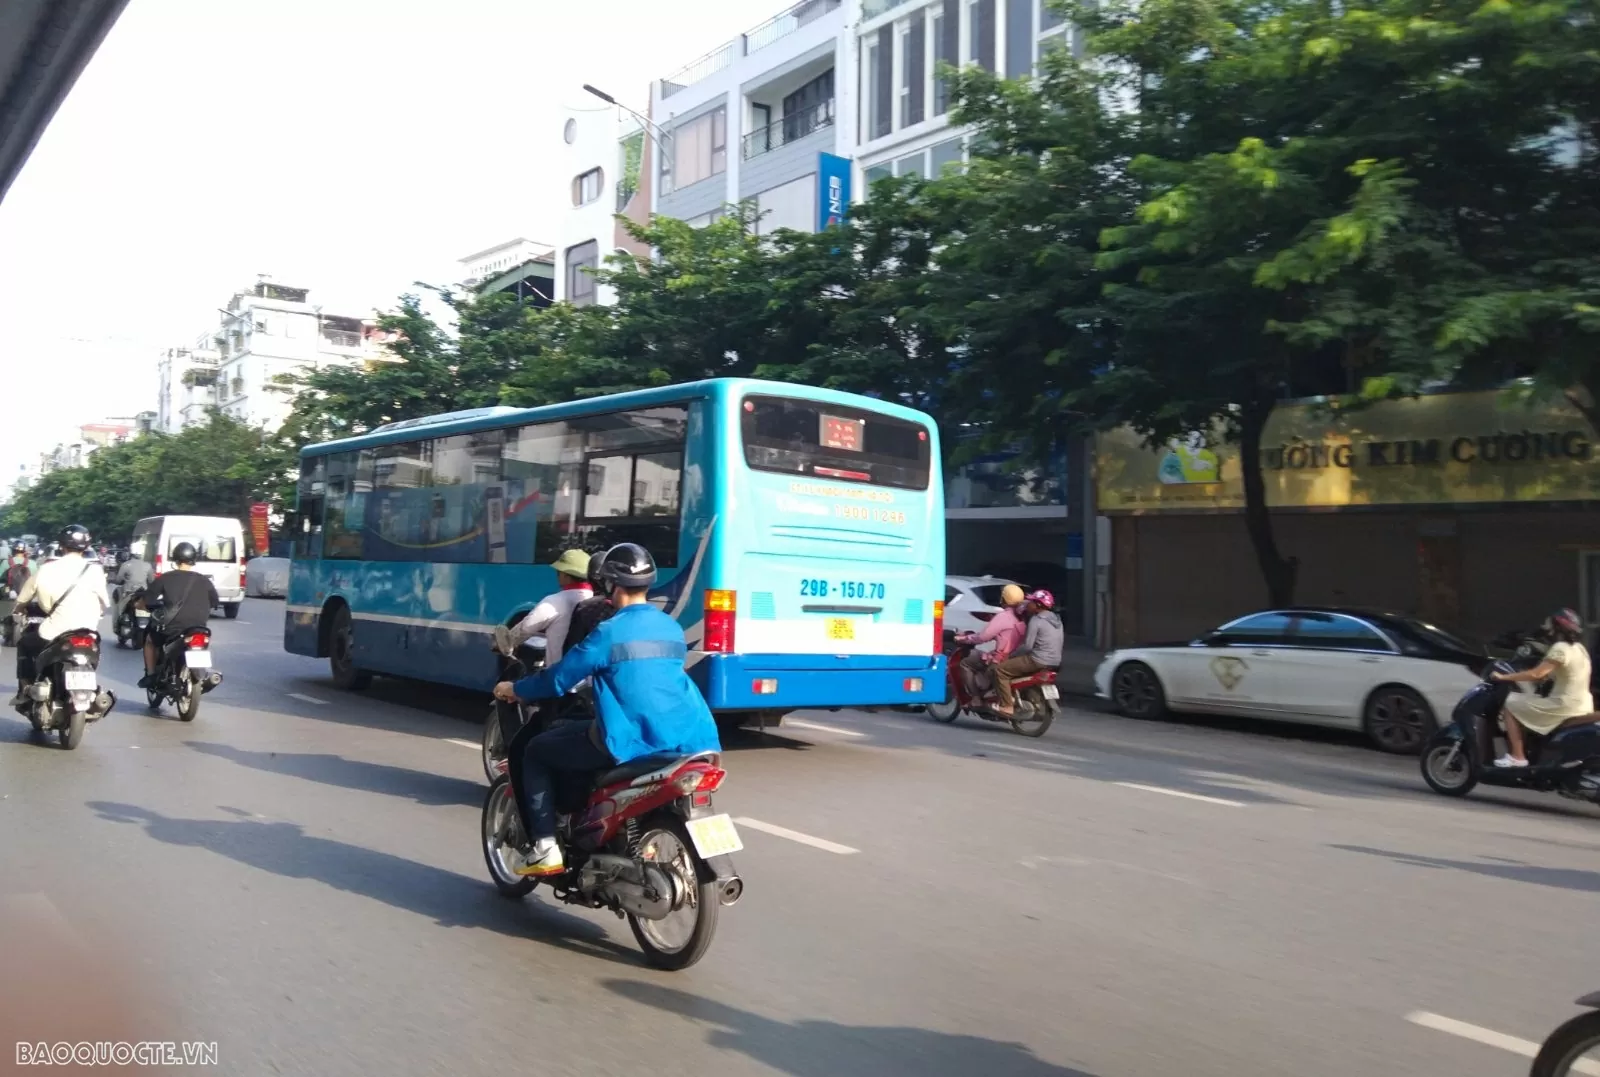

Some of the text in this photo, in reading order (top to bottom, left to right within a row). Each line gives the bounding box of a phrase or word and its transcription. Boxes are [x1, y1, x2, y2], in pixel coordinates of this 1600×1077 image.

[829, 175, 842, 214] NCB
[1367, 438, 1441, 467] KIM
[1452, 429, 1591, 463] CƯƠNG
[836, 505, 867, 520] 1900
[801, 580, 828, 597] 29B
[840, 581, 885, 599] 150.70
